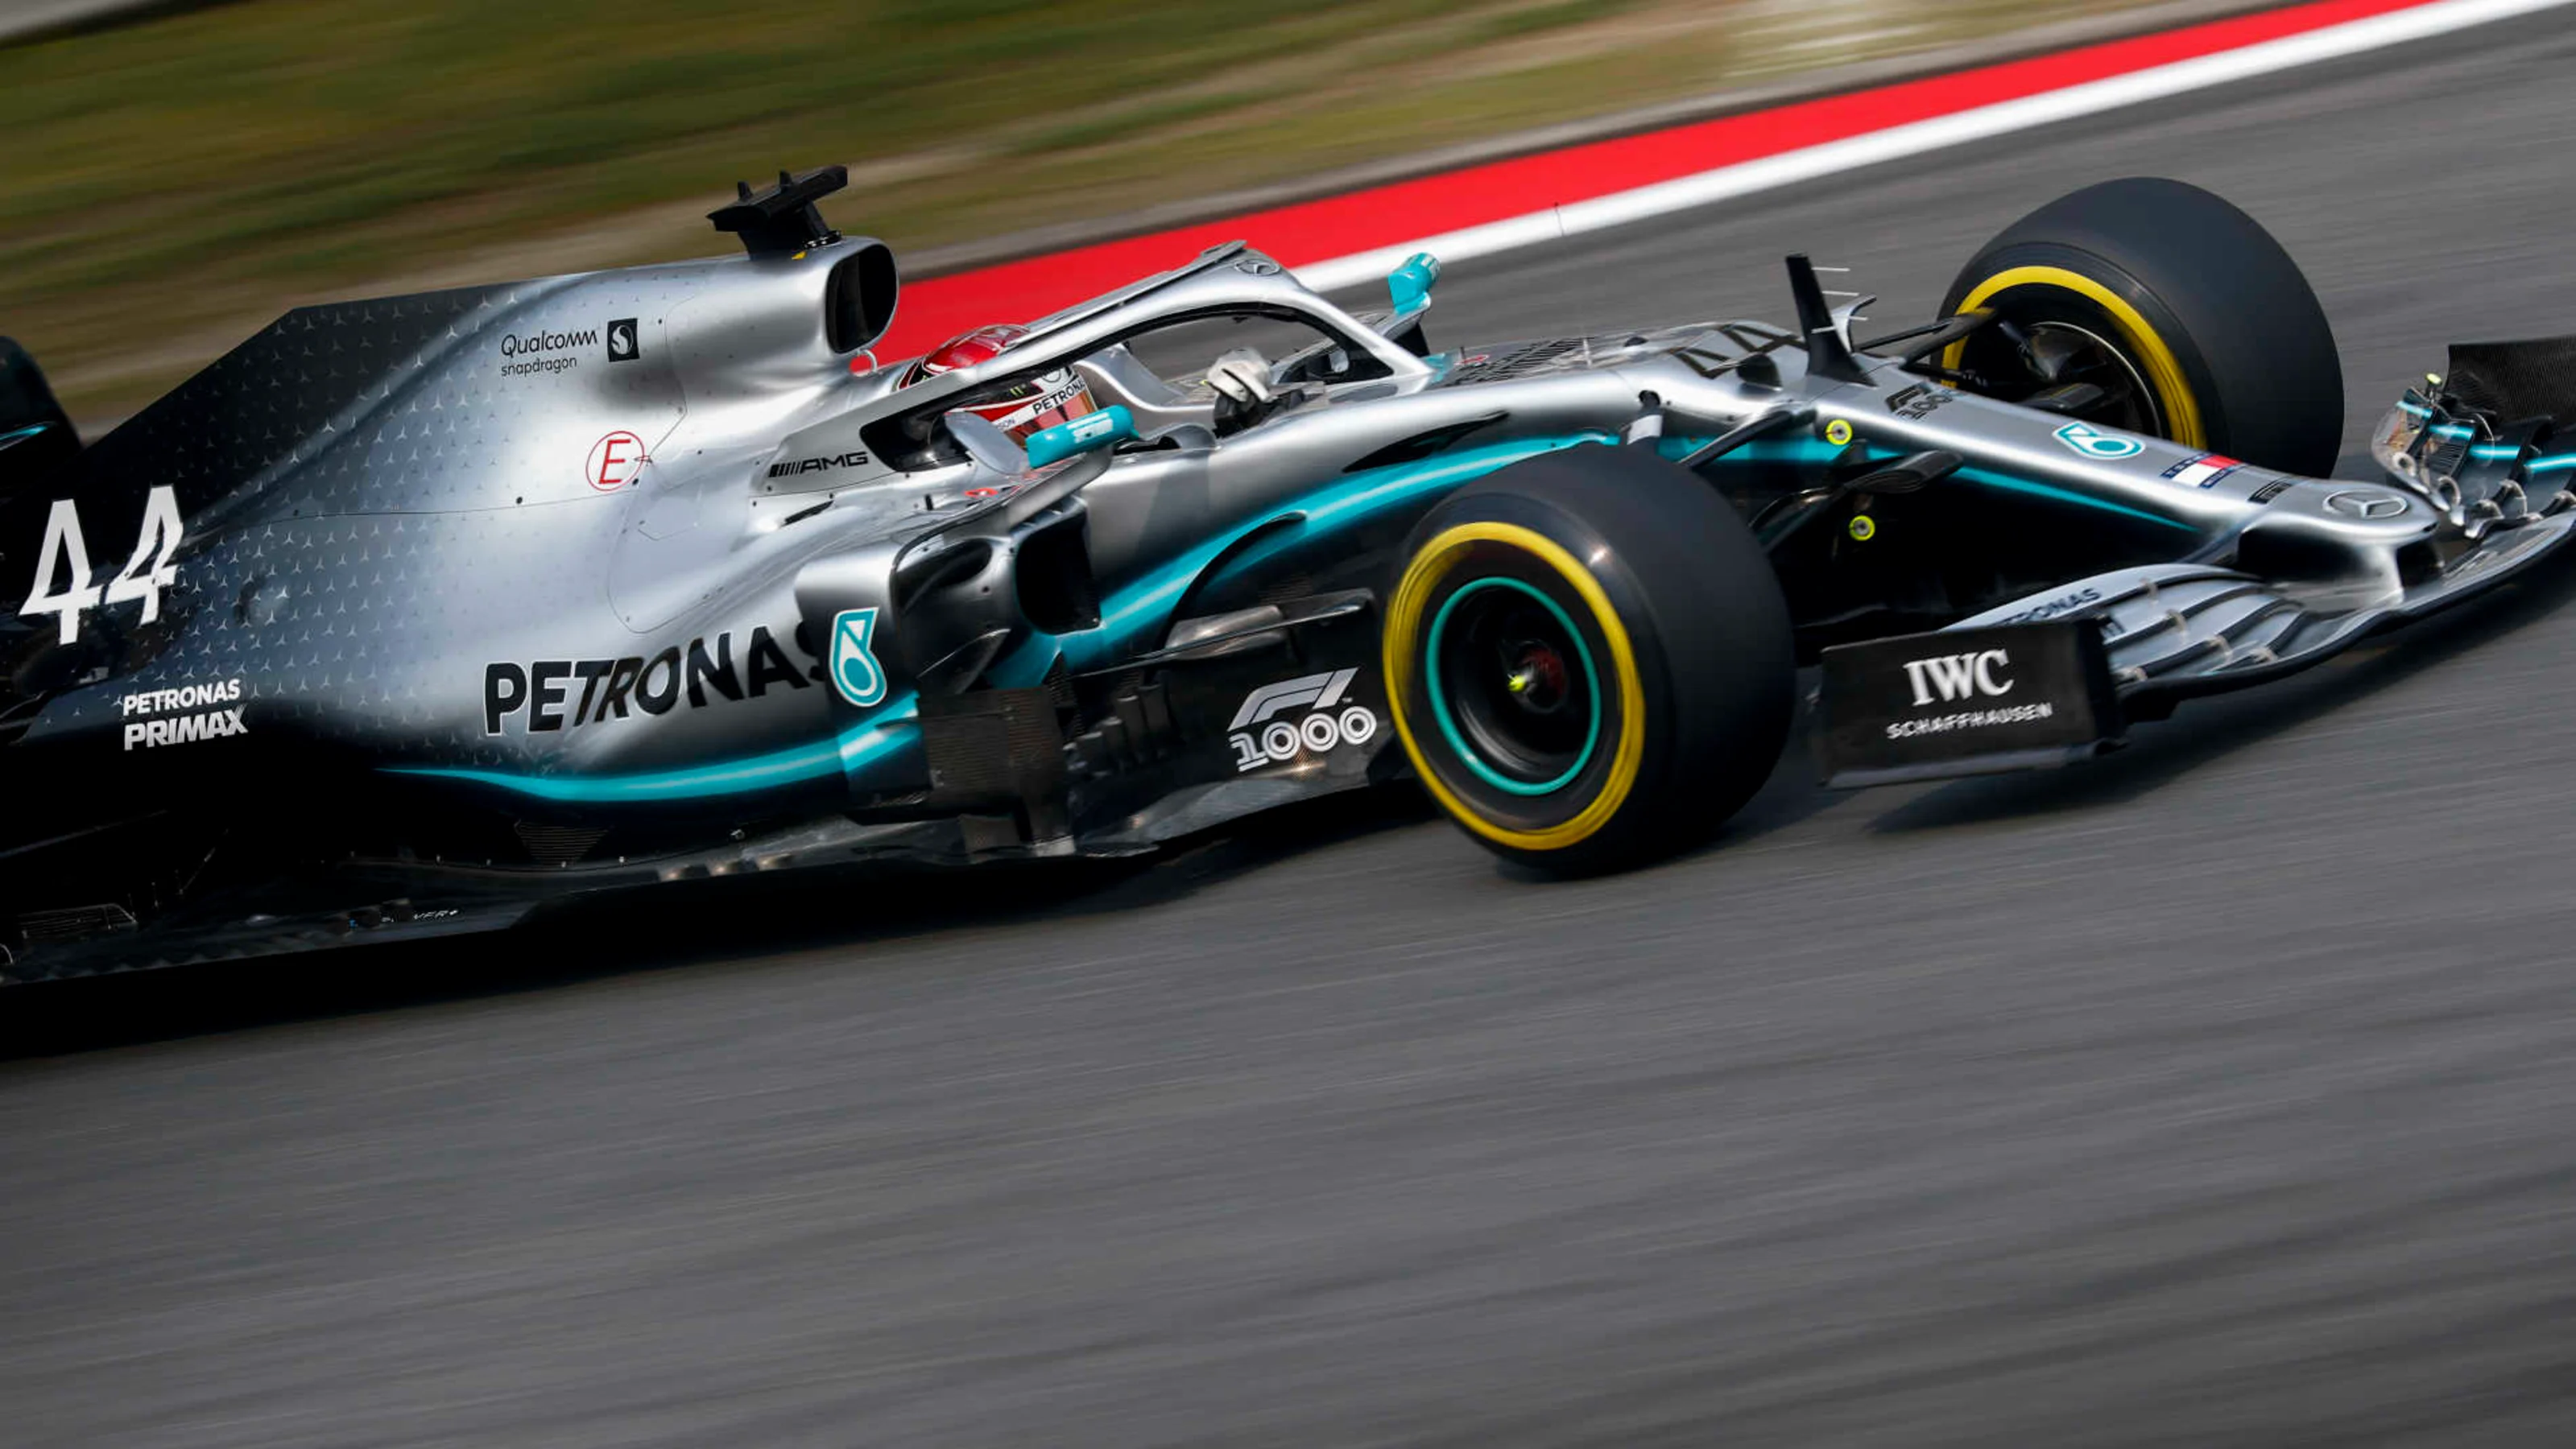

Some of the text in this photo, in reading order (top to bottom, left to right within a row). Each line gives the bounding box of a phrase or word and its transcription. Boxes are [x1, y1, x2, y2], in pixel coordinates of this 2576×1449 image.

[501, 329, 597, 359] Qualcomm
[501, 357, 577, 378] snapdragon
[1032, 378, 1085, 415] PETRONA
[598, 439, 631, 484] E
[19, 485, 184, 645] 44
[122, 678, 241, 716] PETRONAS
[1902, 648, 2014, 707] IWC
[124, 704, 249, 751] PRIMAX
[1229, 706, 1377, 772] 1000
[1886, 702, 2053, 739] SCHAFFHAUSEN
